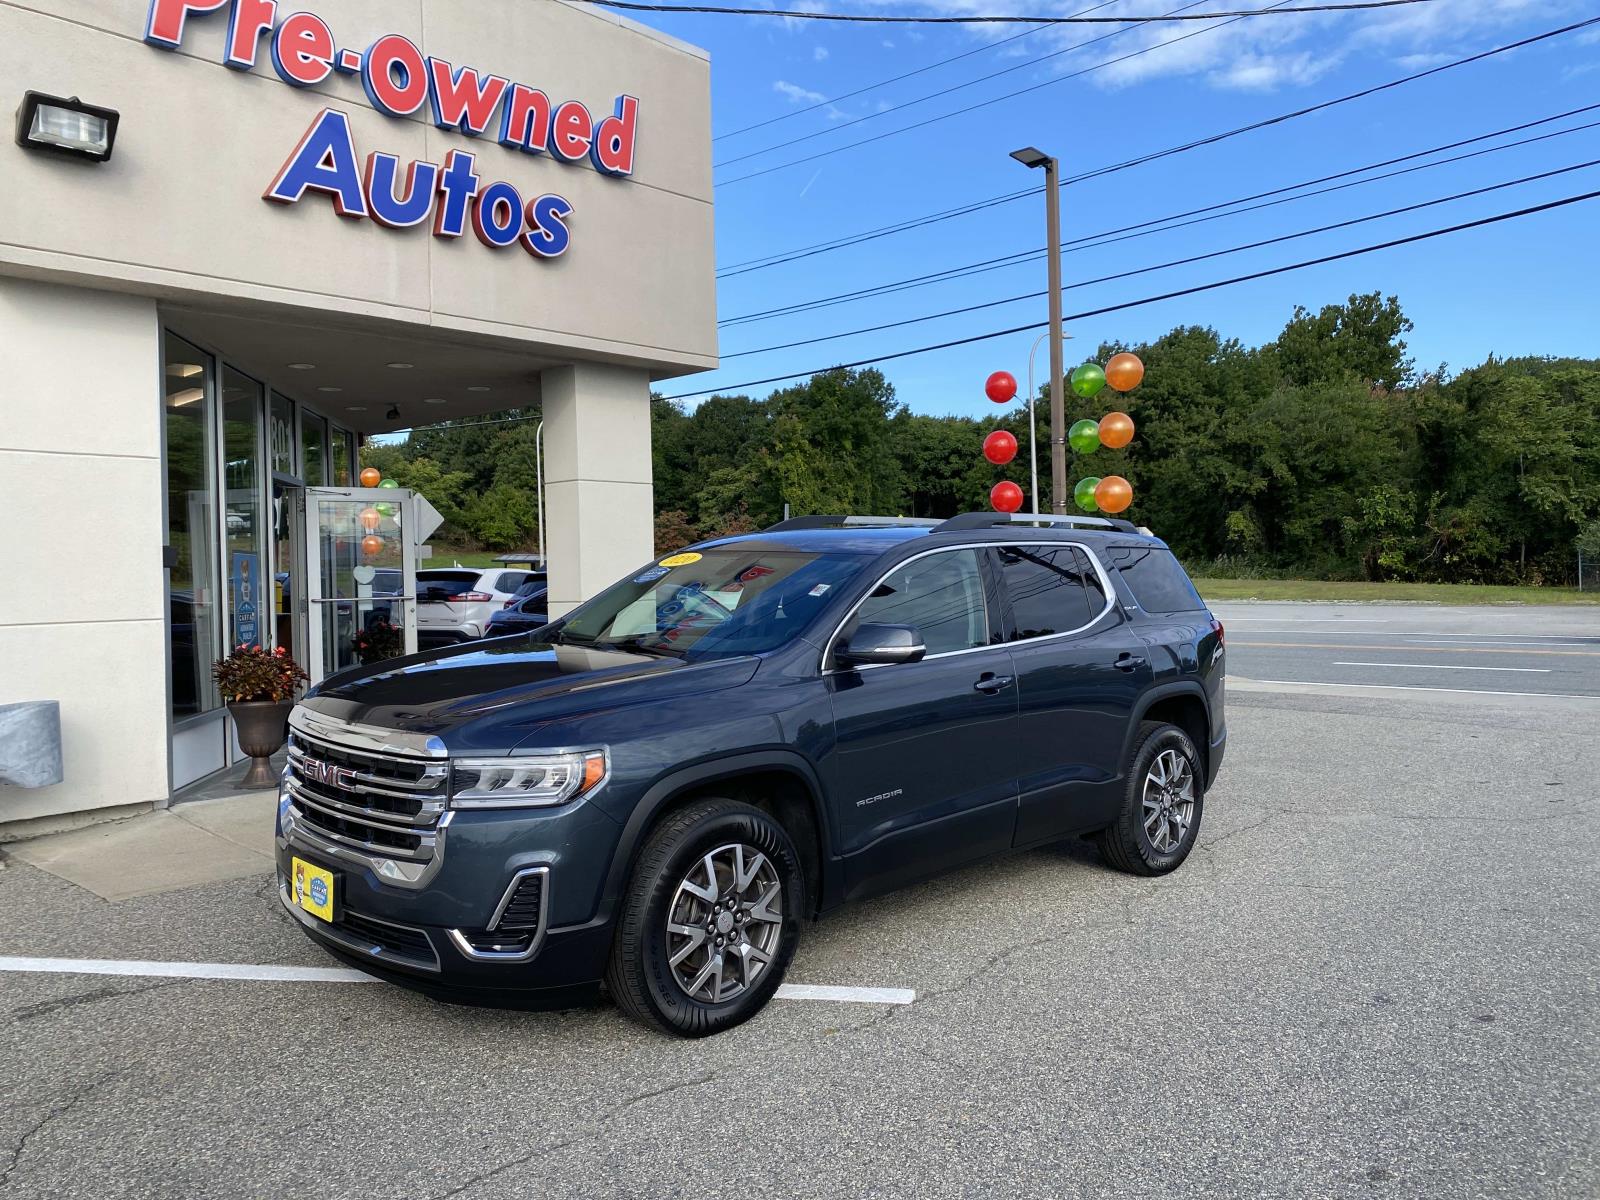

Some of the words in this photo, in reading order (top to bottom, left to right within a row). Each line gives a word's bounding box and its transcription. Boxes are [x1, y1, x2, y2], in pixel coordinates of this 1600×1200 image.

[262, 107, 574, 258] Autos
[303, 757, 357, 792] GMC
[856, 789, 903, 807] ACADIA
